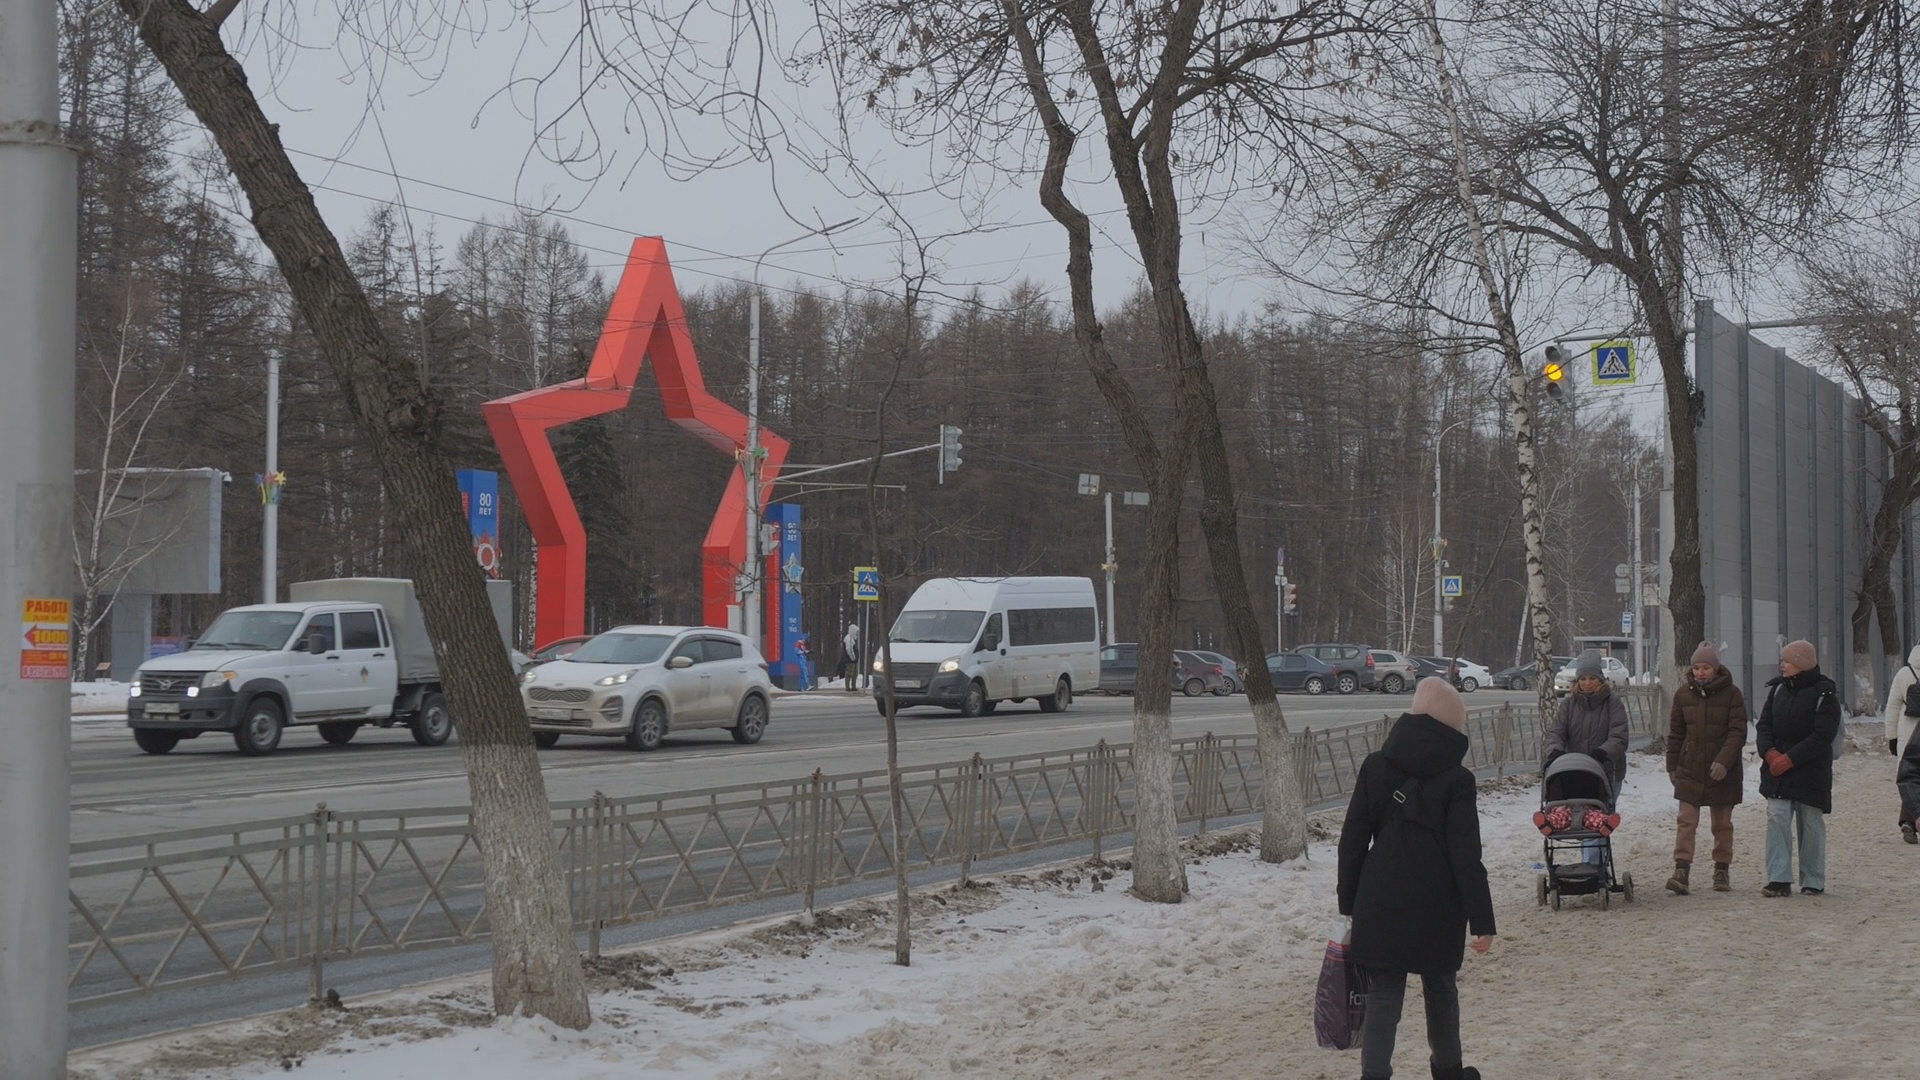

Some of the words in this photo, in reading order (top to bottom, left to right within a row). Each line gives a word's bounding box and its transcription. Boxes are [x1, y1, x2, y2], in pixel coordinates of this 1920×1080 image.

[479, 492, 492, 506] 80
[478, 507, 492, 515] ЛЕТ
[31, 630, 67, 643] 1000
